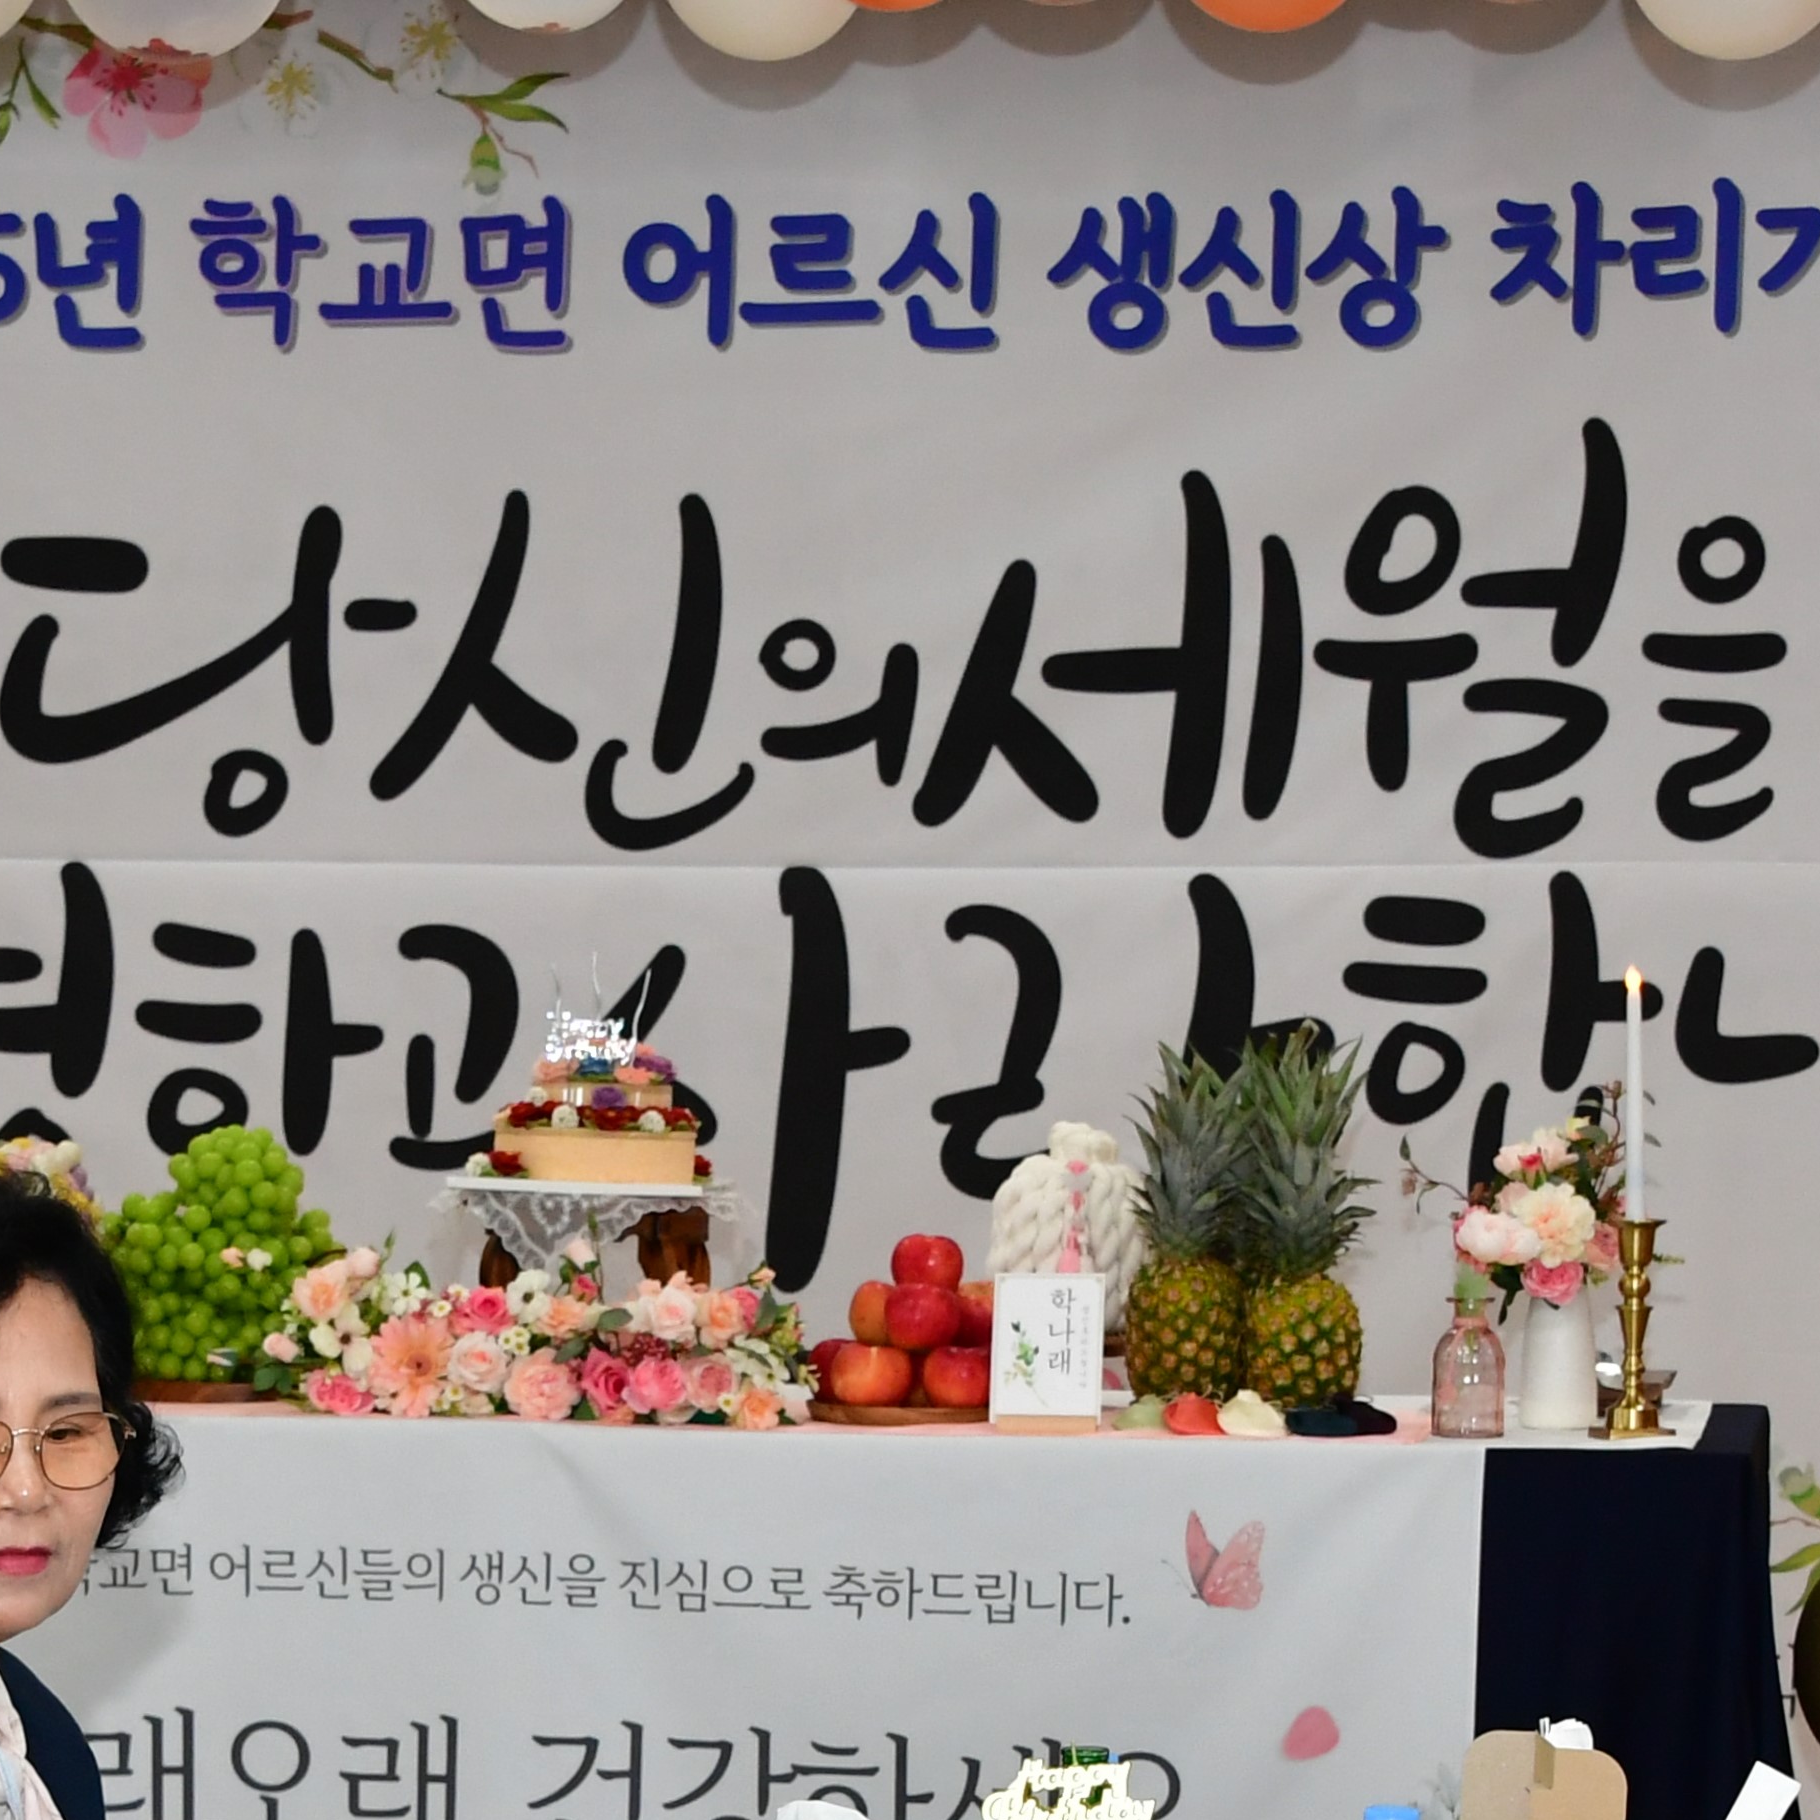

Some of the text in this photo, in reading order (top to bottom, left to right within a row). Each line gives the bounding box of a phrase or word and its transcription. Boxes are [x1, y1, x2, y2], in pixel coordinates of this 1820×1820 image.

[190, 194, 571, 352] 학교면
[622, 192, 999, 351] 어르신
[1047, 186, 1449, 351] 생신상
[911, 417, 1788, 859] 세월을
[208, 1543, 447, 1604] 어르신들의
[459, 1550, 608, 1610] 생신을
[618, 1556, 813, 1614] 진심으로
[821, 1563, 1133, 1629] 축하드립니다.
